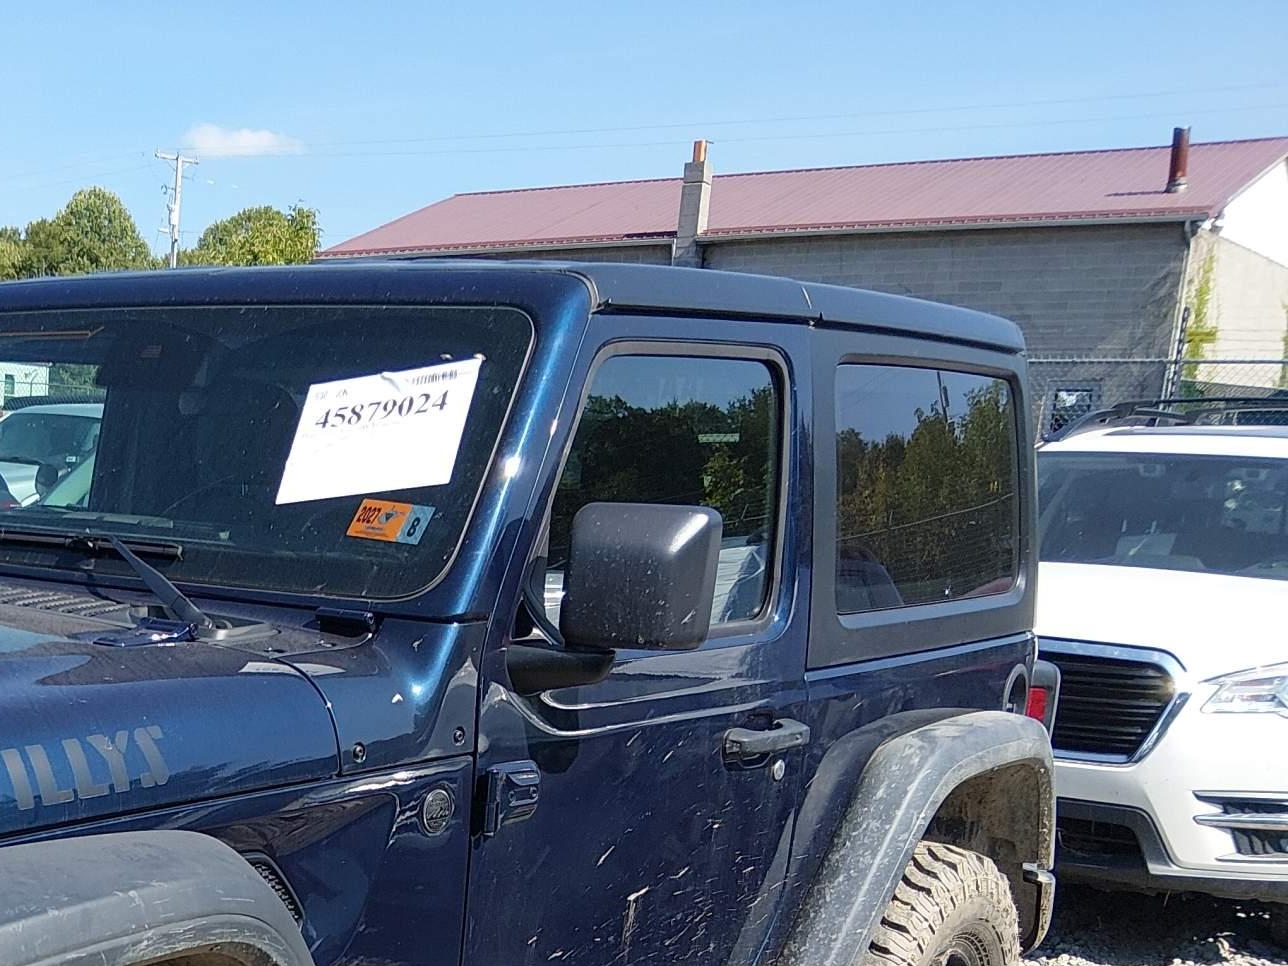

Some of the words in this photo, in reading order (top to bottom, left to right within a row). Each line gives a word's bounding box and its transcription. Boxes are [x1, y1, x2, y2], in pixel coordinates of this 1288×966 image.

[315, 391, 449, 428] 45879024
[357, 507, 382, 524] 2027
[407, 517, 421, 537] 8
